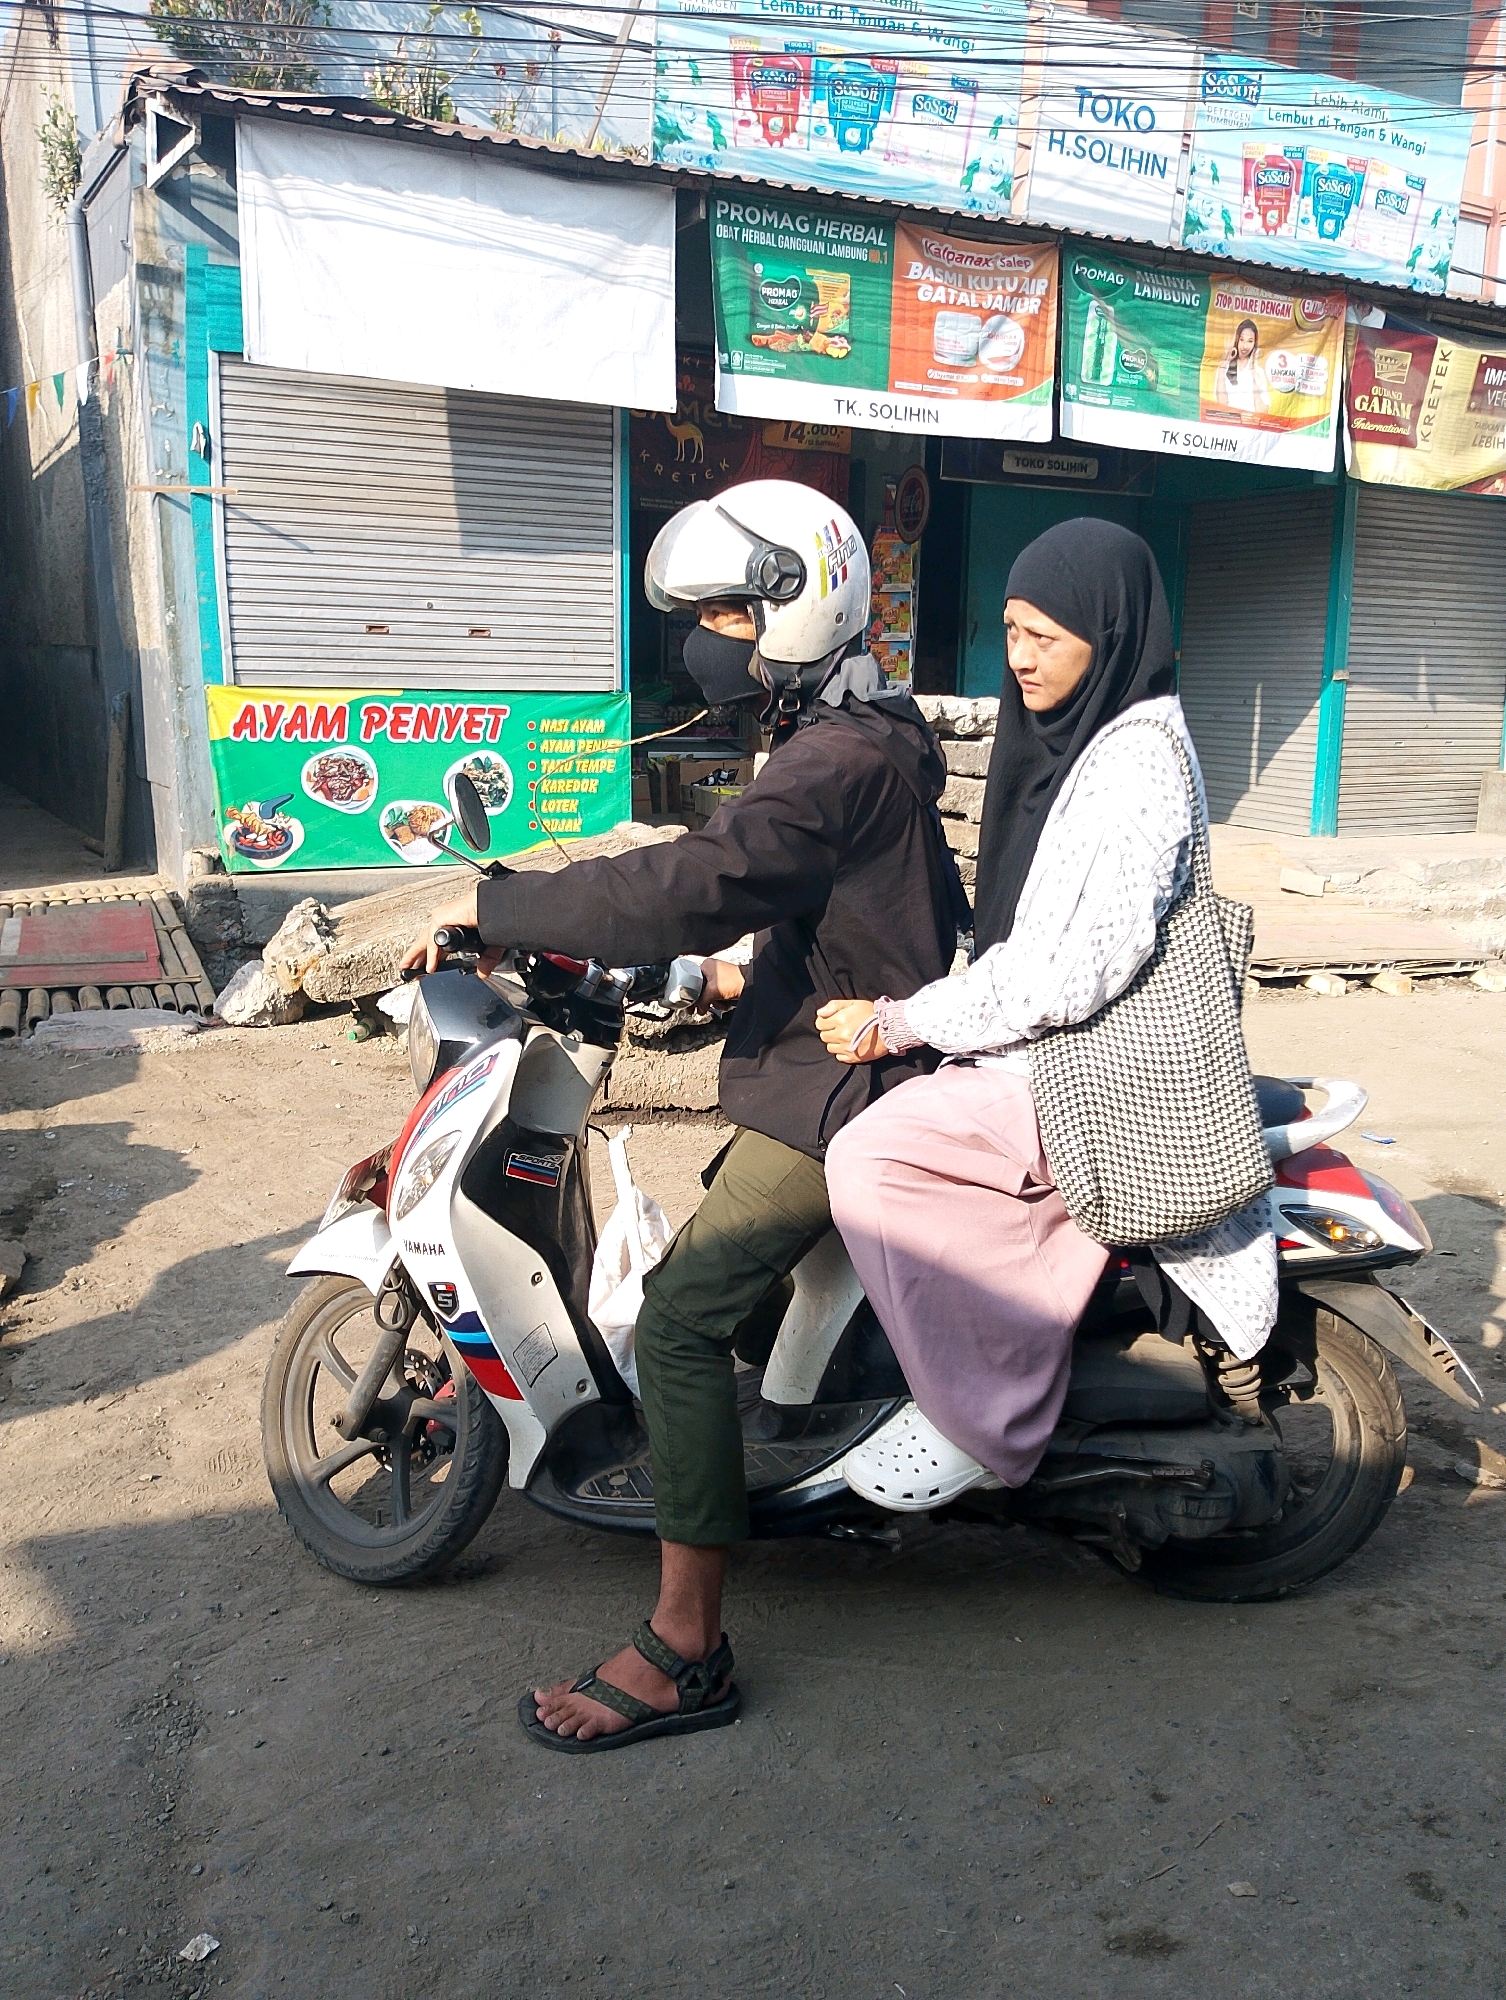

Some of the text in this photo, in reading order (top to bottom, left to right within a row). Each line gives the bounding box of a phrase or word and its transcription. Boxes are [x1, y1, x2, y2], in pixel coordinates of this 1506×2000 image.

[1075, 88, 1155, 133] TOKO
[1268, 107, 1427, 154] Lembut di Tangan & Wangi
[1048, 130, 1168, 179] H.SOLIHIN
[716, 200, 888, 247] PROMAG HERBAL
[716, 224, 739, 241] OBAT
[742, 228, 777, 248] HERBAL
[778, 234, 825, 255] GANGGUAN
[826, 242, 868, 262] LAMBUNG
[923, 239, 1032, 272] Kalpanax Salep
[906, 261, 1049, 296] BASMI KUTU AIR
[761, 286, 798, 299] PROMAG
[917, 283, 1042, 314] GATAL JAMUR
[1134, 282, 1200, 307] LAMBUNG
[1215, 292, 1293, 319] STOP DIARE DENGAN
[1278, 354, 1288, 368] 3
[1354, 395, 1413, 420] GARAM
[1421, 349, 1453, 443] KRETEK
[834, 399, 939, 423] TK. SOLIHIN
[1351, 417, 1411, 436] International
[1161, 430, 1238, 453] TK SOLIHIN
[1471, 434, 1506, 449] LEBIH
[640, 449, 730, 484] KRETEK
[1014, 457, 1088, 473] TOKO SOLIHIN
[232, 703, 508, 743] AYAM PENYET
[539, 719, 605, 733] NASI AYAM
[540, 739, 575, 753] AYAM
[575, 759, 616, 773] TEMPE
[541, 779, 599, 794] KAREDOK
[541, 798, 579, 813] LOTEK
[516, 1154, 557, 1169] SPORTS
[403, 1239, 445, 1256] YAMAHA
